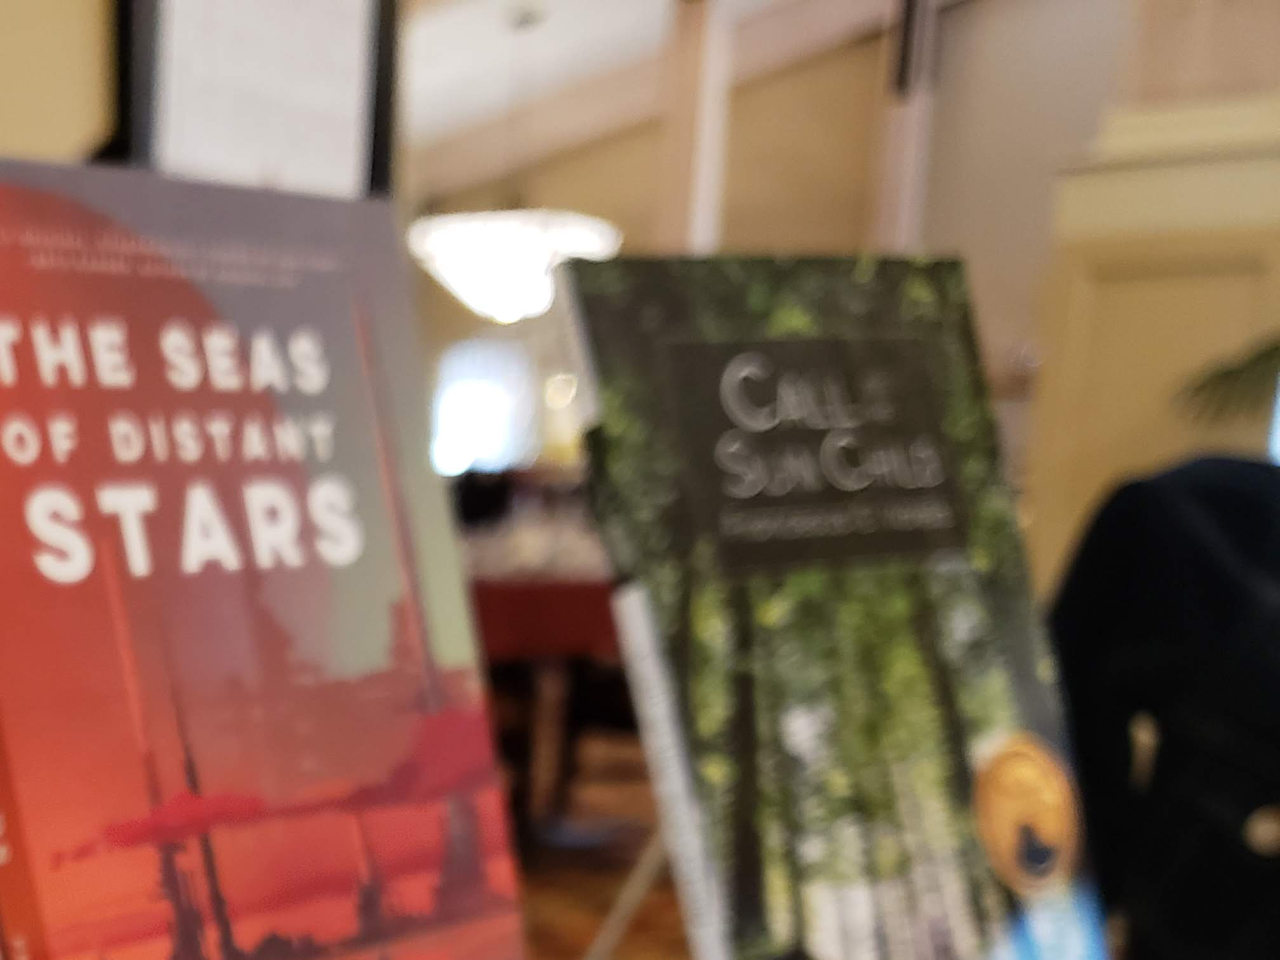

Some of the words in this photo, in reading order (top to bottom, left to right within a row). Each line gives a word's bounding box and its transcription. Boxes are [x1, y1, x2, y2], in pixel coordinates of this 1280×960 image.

[159, 316, 330, 396] SEAS
[0, 411, 79, 465] OF
[107, 411, 336, 466] DISTANT
[23, 473, 365, 585] STARS
